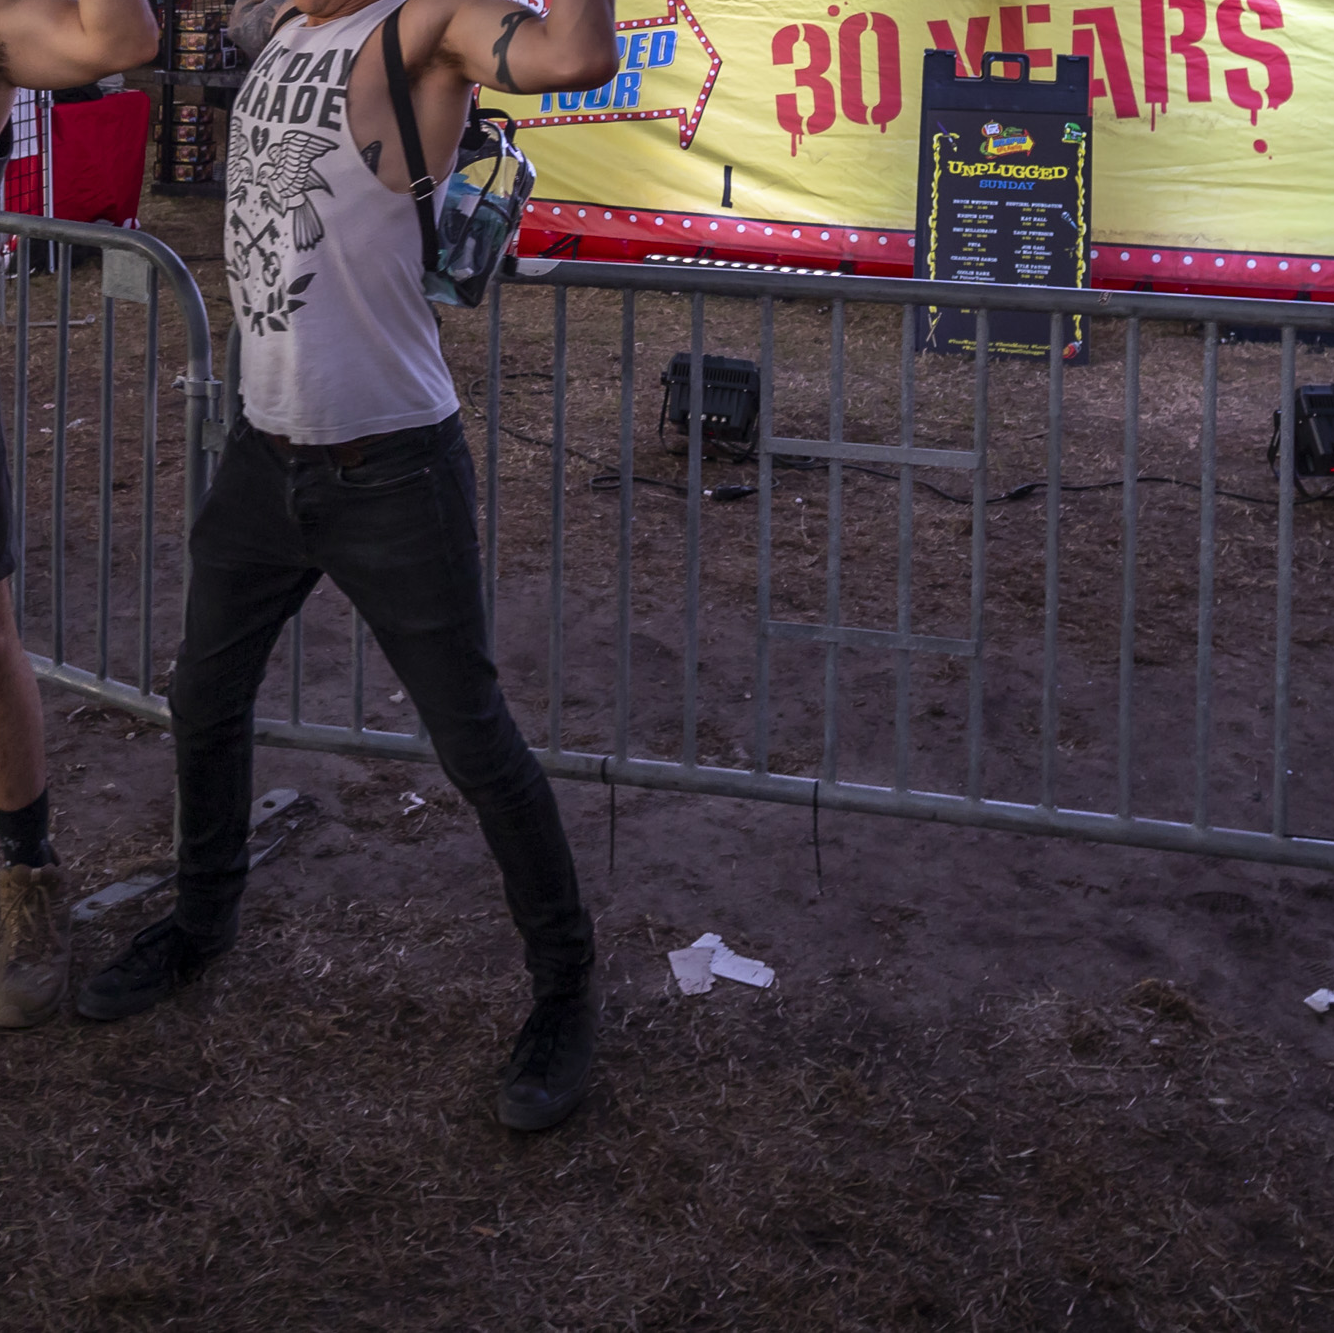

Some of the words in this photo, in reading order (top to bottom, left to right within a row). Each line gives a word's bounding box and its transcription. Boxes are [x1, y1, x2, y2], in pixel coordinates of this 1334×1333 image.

[771, 10, 903, 137] 30
[236, 76, 346, 131] ARADE
[948, 161, 1068, 180] UNPLUGGED
[979, 180, 1035, 190] SUNDAY
